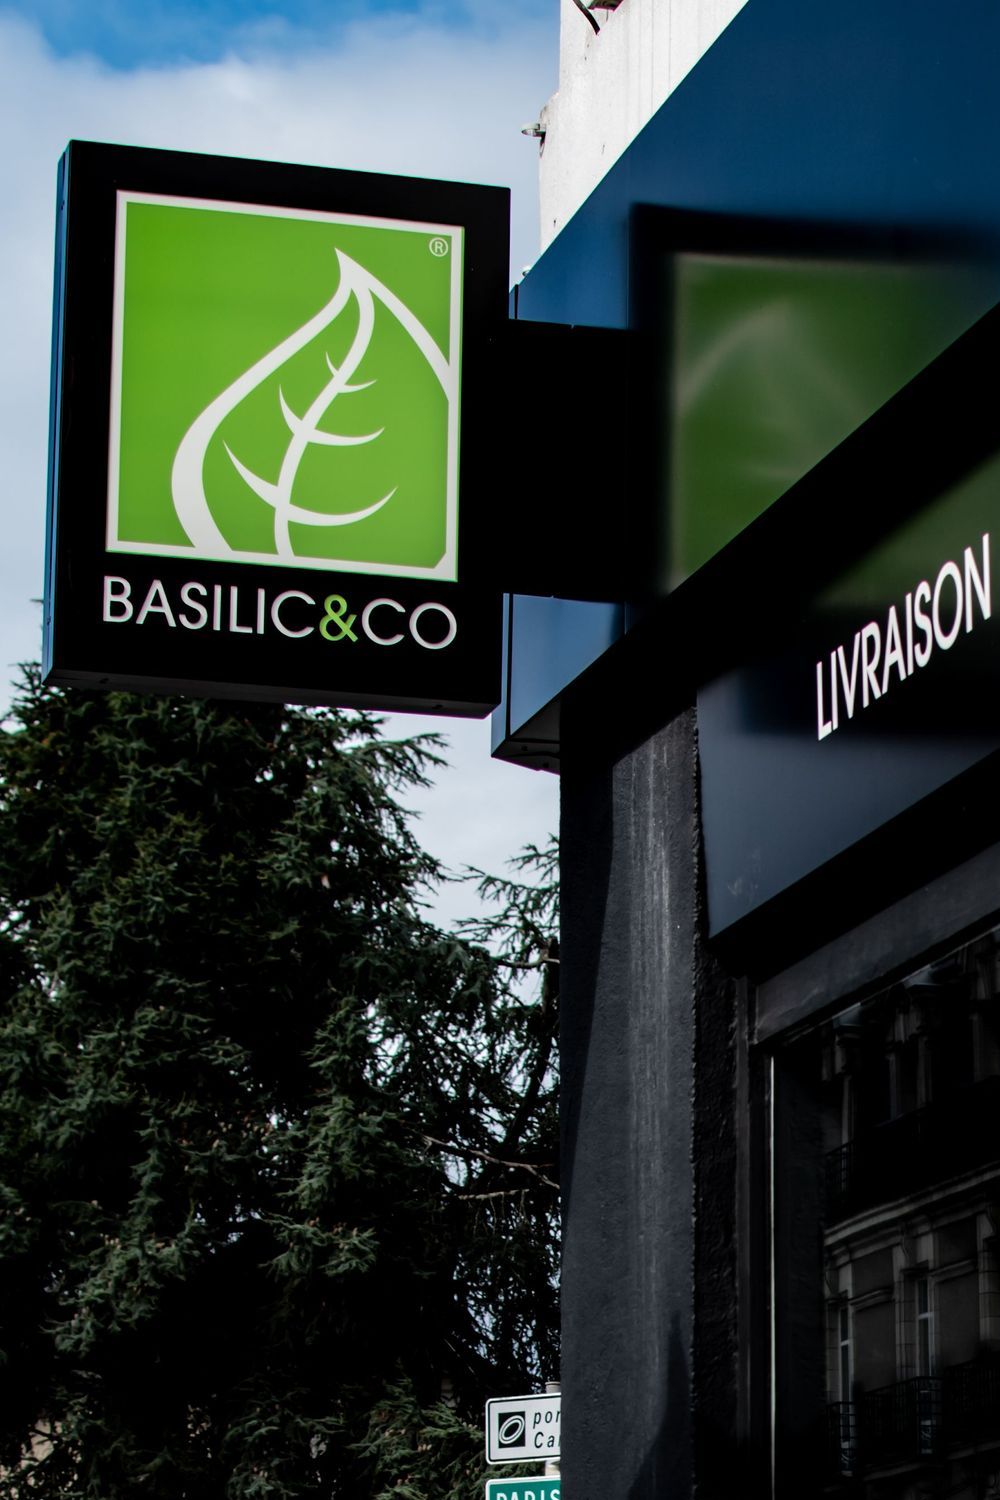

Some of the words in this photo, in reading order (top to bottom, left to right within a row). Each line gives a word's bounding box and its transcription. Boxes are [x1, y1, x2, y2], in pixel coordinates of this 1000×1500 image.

[102, 575, 458, 650] BASILIC&CO
[816, 533, 992, 741] LIVRAISON
[534, 1432, 561, 1448] Ca
